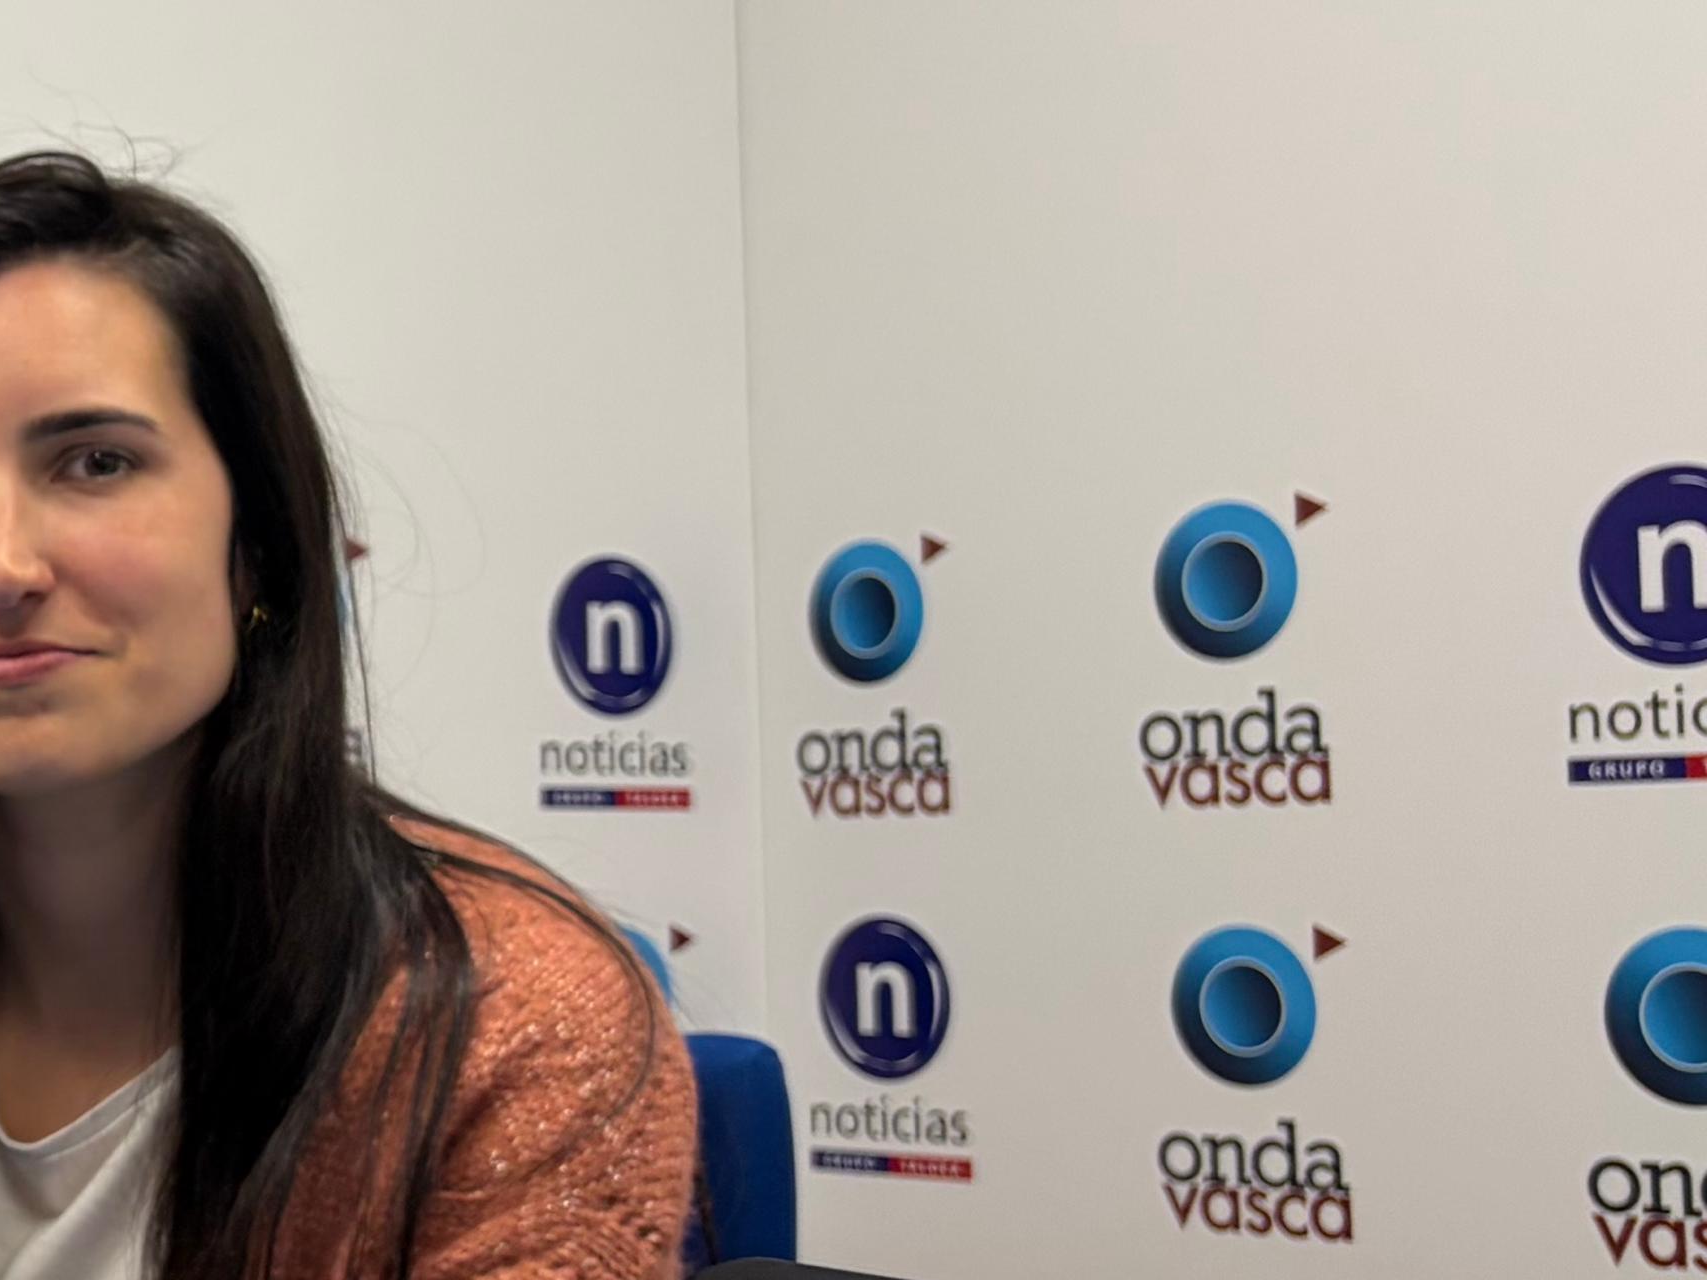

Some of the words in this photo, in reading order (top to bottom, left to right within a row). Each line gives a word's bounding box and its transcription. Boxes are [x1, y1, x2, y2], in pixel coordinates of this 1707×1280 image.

[1637, 520, 1707, 613] n
[585, 599, 645, 675] n
[540, 729, 688, 776] noticias
[797, 706, 947, 776] onda
[1139, 686, 1329, 762] onda
[800, 770, 951, 818] vasca
[1142, 756, 1332, 810] vasca
[1589, 760, 1665, 779] GRUPO
[855, 960, 913, 1038] n
[809, 1093, 970, 1146] noticias
[1158, 1118, 1350, 1192] onda
[1162, 1183, 1353, 1243] vasca
[1588, 1157, 1707, 1217] on
